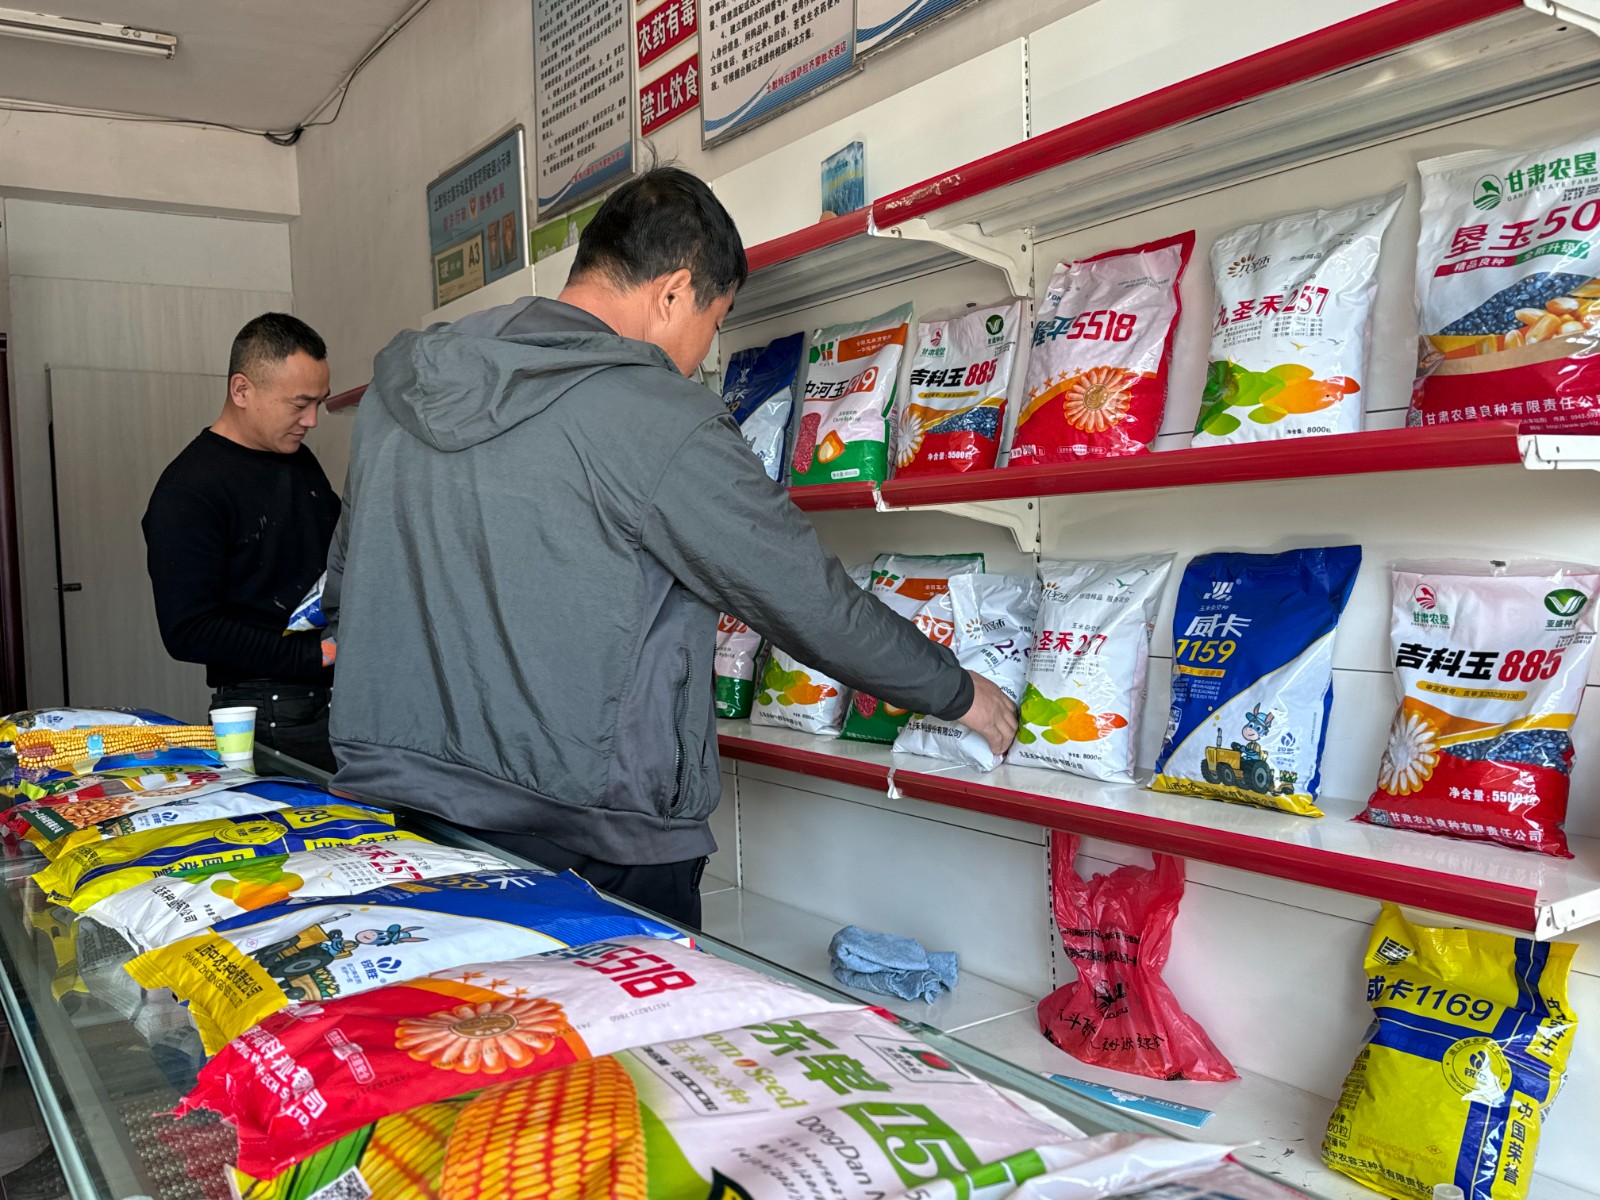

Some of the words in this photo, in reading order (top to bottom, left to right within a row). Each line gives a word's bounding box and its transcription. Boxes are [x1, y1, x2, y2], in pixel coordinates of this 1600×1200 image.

[639, 0, 696, 57] 农药有毒
[641, 65, 698, 126] 禁止饮食
[1505, 152, 1599, 193] 甘肃农垦
[1454, 258, 1505, 271] 精品良种
[1524, 241, 1575, 262] 全新升级
[1213, 285, 1330, 332] 九圣禾257
[910, 358, 998, 388] 吉科玉885
[1184, 613, 1252, 638] 威卡
[1412, 611, 1450, 625] 甘肃农垦
[1175, 638, 1237, 664] 1159
[1395, 642, 1566, 683] 吉科玉885
[1389, 811, 1544, 843] 甘肃农垦良种有限责任公司
[360, 959, 378, 980] 锐胜
[665, 1042, 750, 1104] 玉米杂交种
[741, 1020, 893, 1096] 东单
[743, 1066, 808, 1109] Seed
[796, 1115, 872, 1185] DongDan
[1503, 1101, 1534, 1186] 中国荣誉
